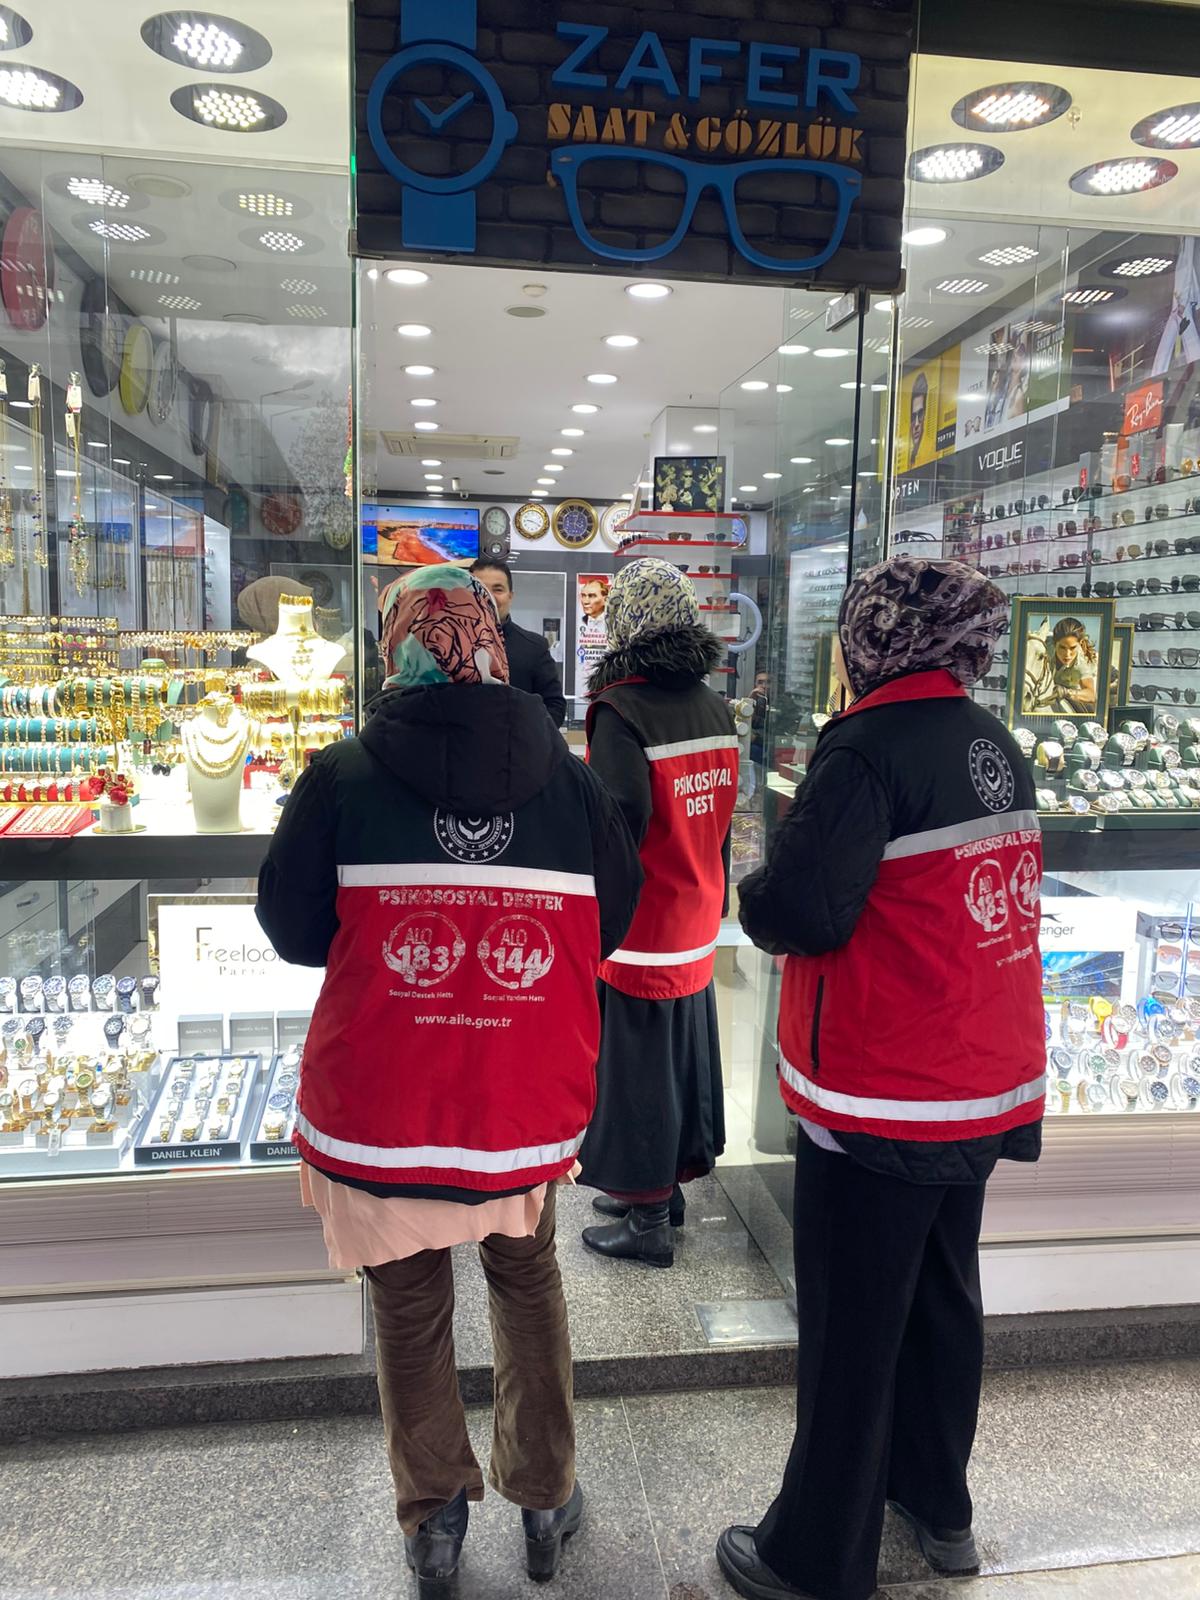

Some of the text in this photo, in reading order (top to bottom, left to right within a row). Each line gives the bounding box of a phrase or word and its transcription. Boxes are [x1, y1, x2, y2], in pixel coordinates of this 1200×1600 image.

[551, 22, 861, 113] ZAFER
[547, 103, 655, 143] SAAT
[502, 892, 564, 911] DESTEK
[196, 927, 281, 962] Freeloo
[404, 927, 433, 945] ALO
[500, 928, 529, 946] ALO
[396, 945, 450, 973] 183
[491, 946, 544, 974] 144
[414, 1014, 512, 1029] www.aile.gov.tr
[151, 1150, 188, 1160] DANIEL
